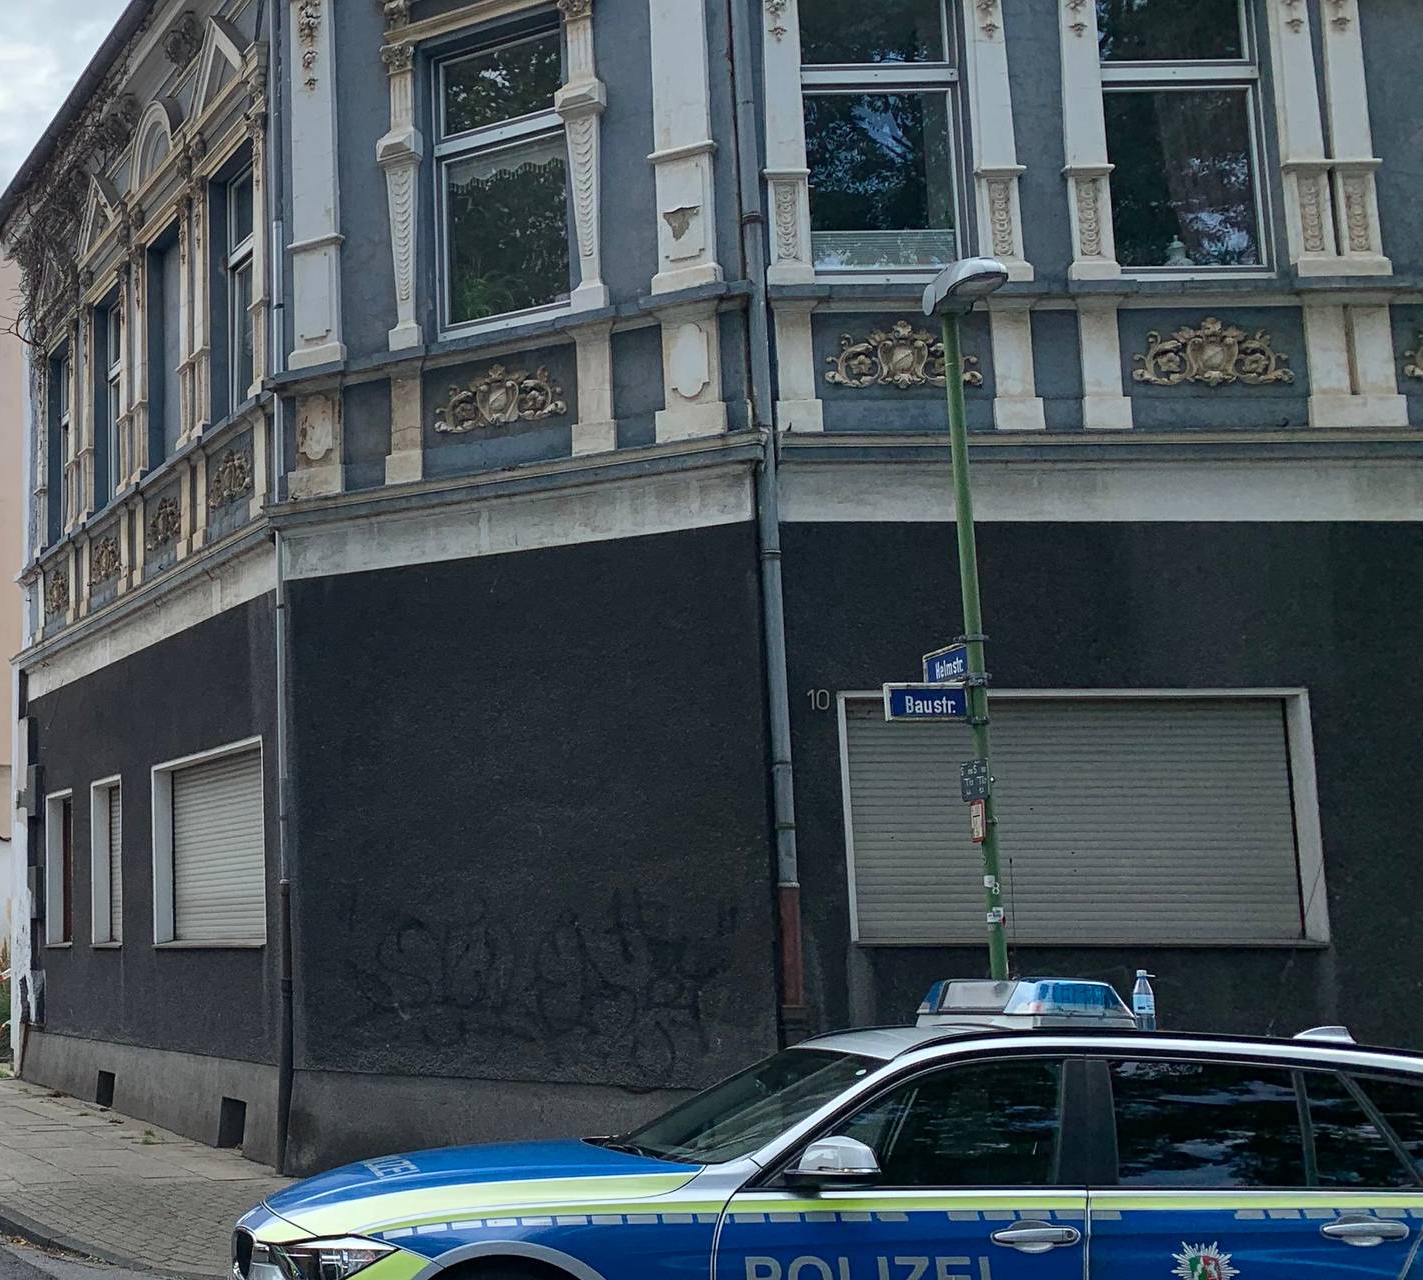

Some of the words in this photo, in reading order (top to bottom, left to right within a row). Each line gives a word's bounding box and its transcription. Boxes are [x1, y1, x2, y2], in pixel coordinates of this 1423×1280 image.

[935, 656, 964, 680] Helmstr.
[807, 689, 830, 710] 10
[904, 695, 957, 714] Baustr.
